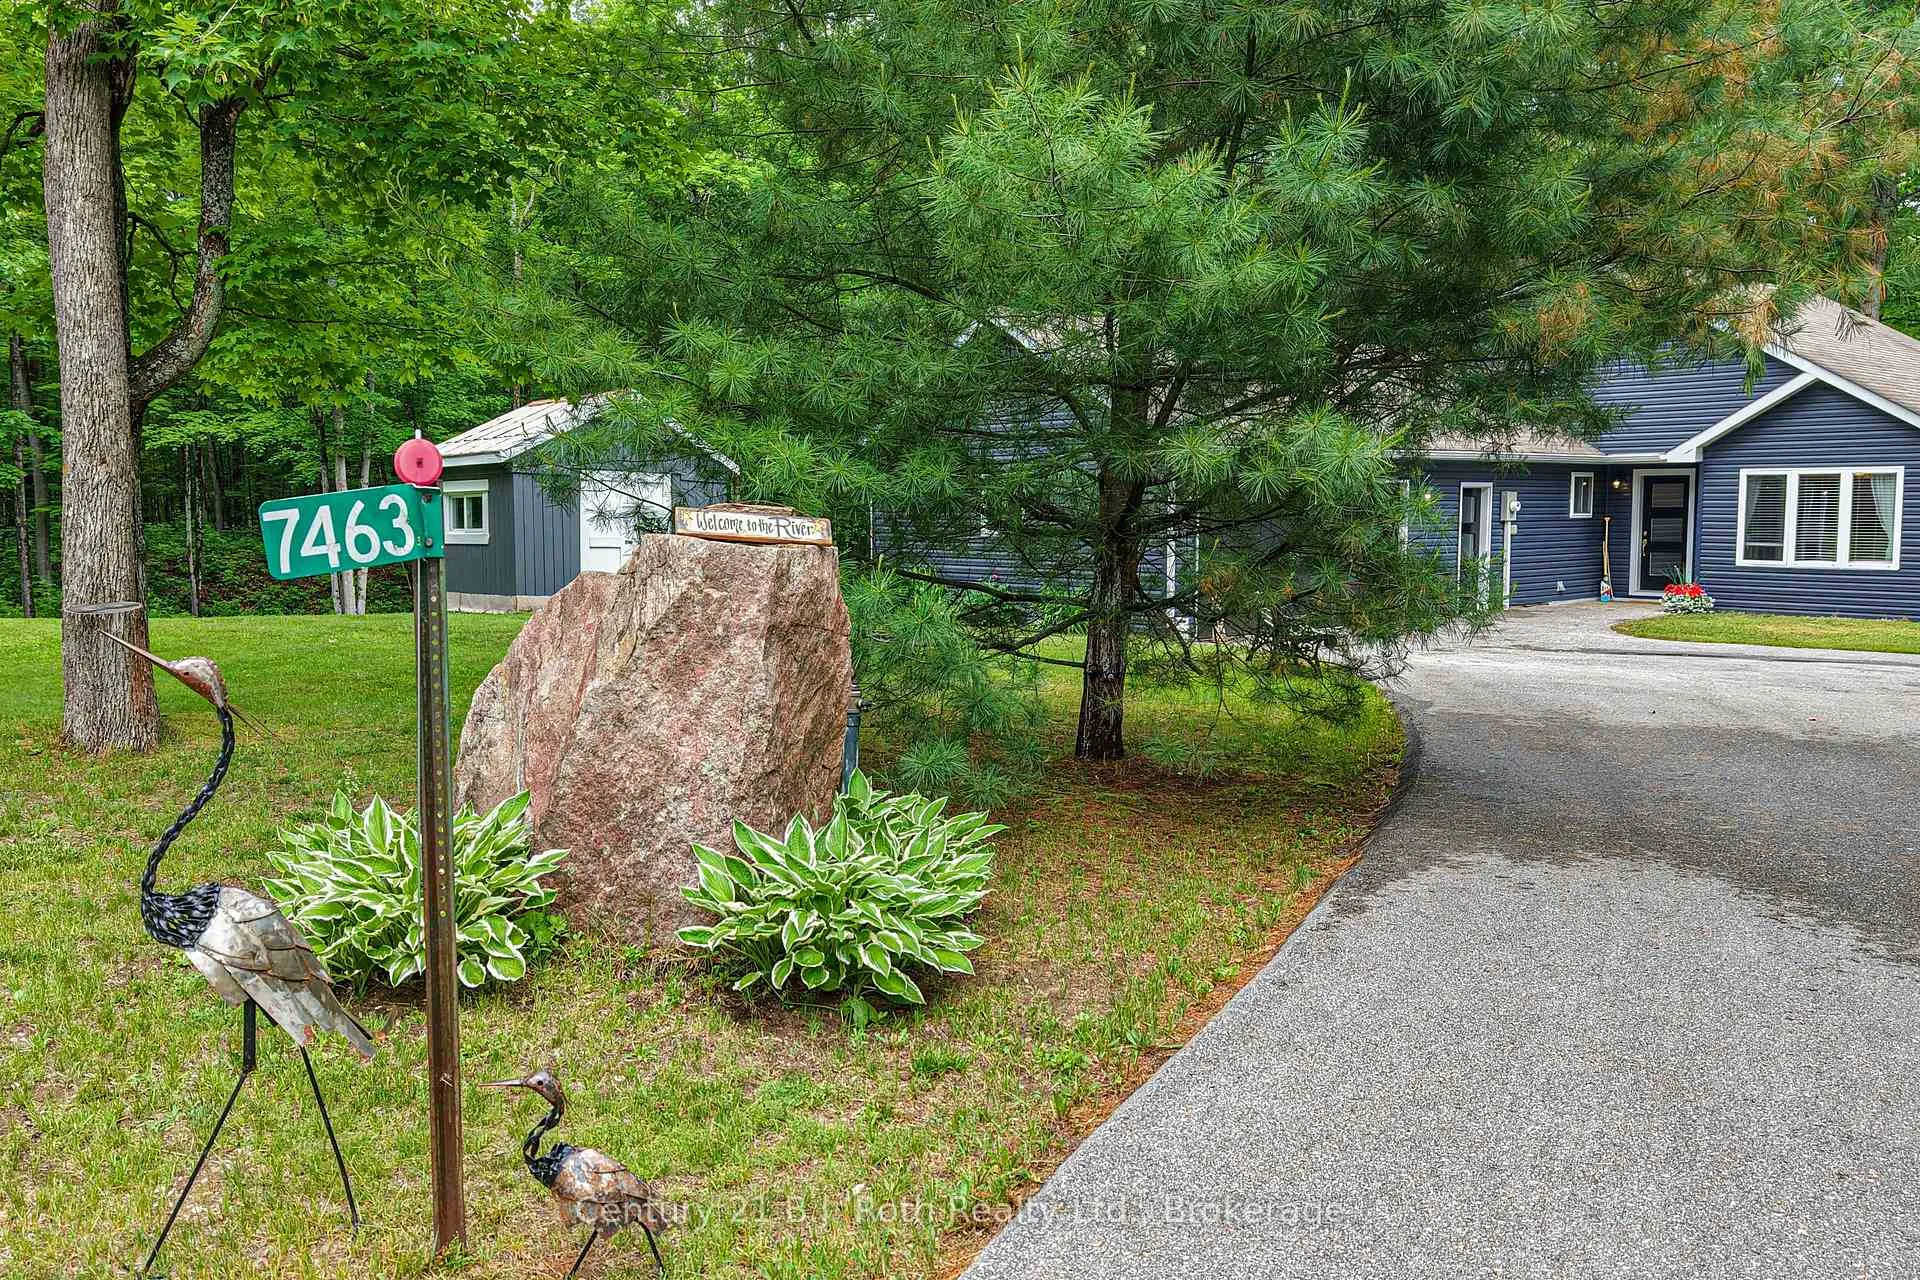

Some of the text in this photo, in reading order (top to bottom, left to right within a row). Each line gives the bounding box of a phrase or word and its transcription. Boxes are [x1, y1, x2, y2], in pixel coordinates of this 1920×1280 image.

[263, 494, 415, 574] 7463
[696, 511, 813, 539] Welcome to the River
